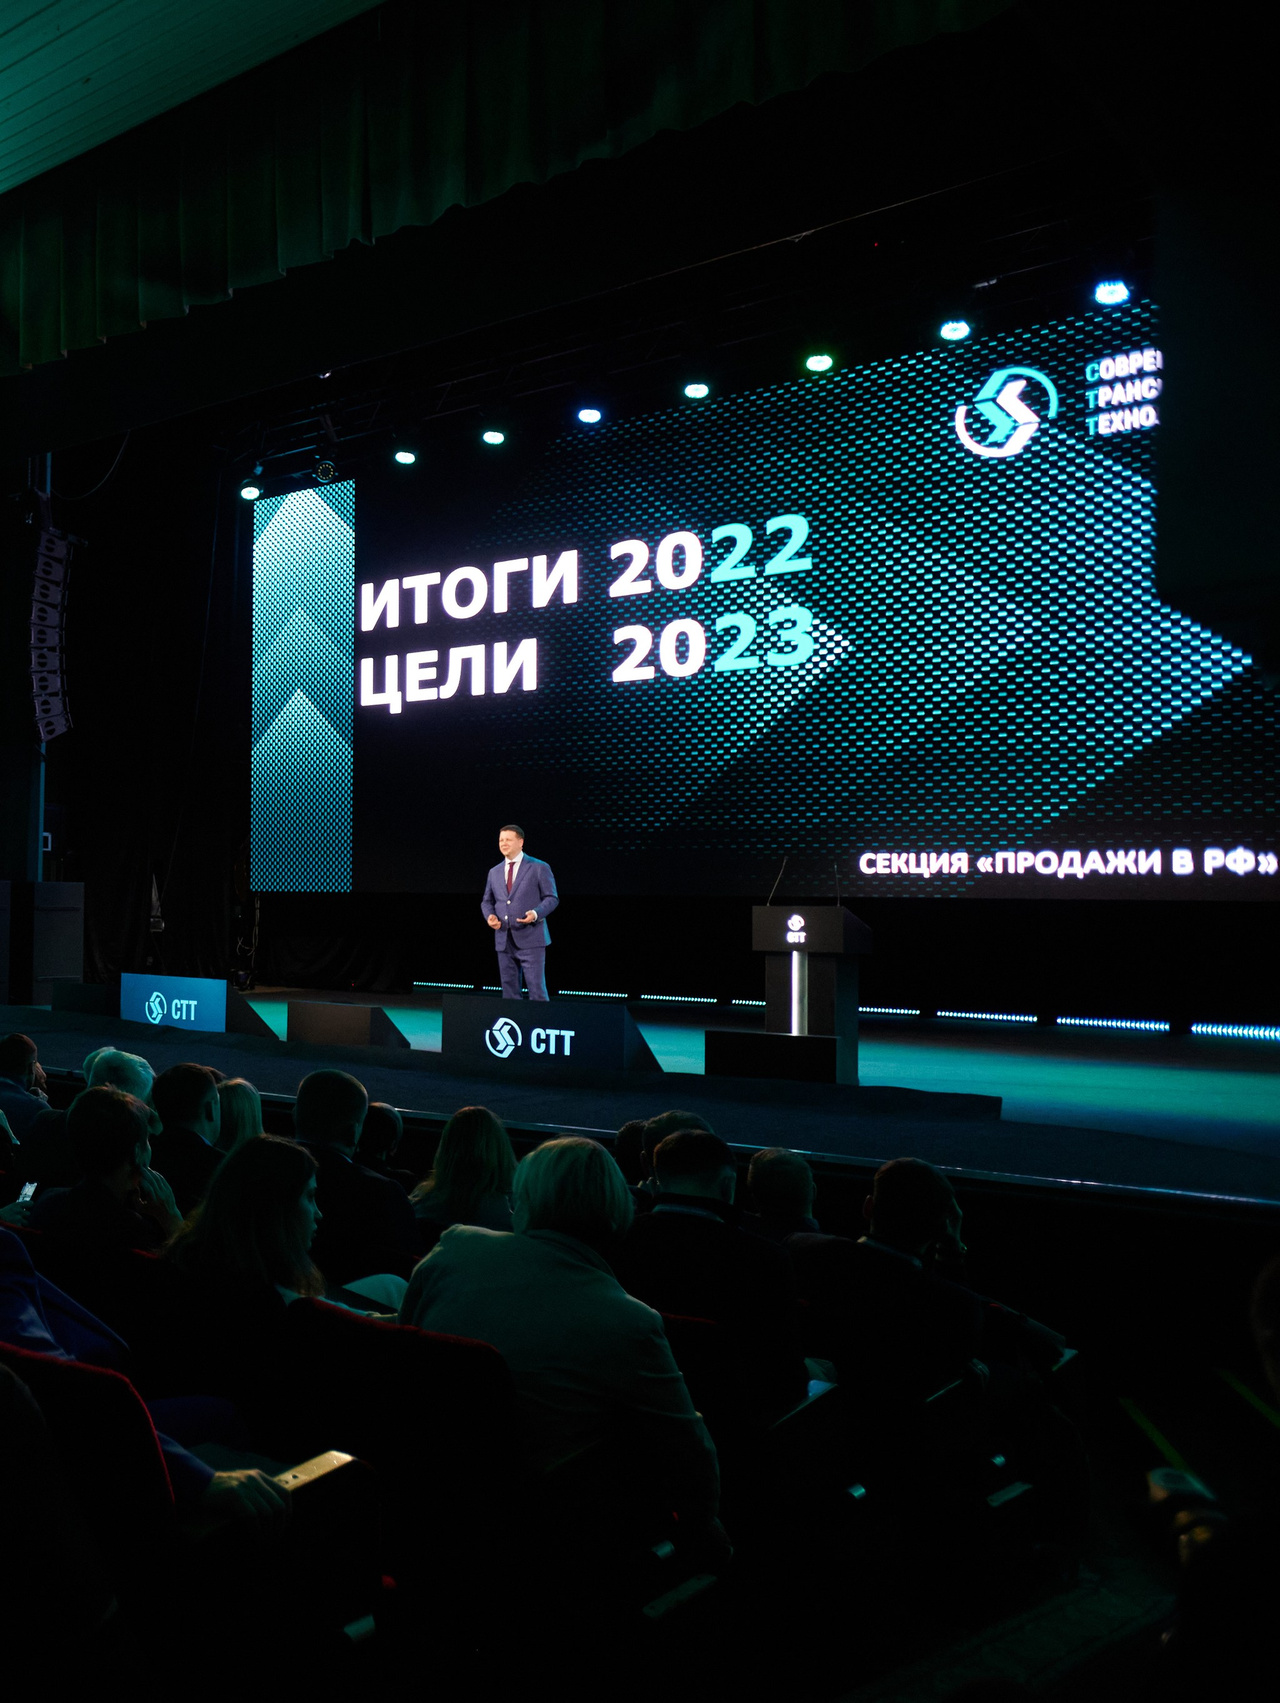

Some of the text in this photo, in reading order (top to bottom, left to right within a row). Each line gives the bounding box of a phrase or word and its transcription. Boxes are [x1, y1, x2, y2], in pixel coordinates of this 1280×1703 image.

[1085, 376, 1163, 409] ТРАНС
[1085, 403, 1160, 436] ТЕХНО
[360, 513, 813, 632] ИТОГИ 2022
[360, 605, 816, 714] ЦЕЛИ 2023
[858, 846, 1279, 880] СЕКЦИЯ «ПРОДАЖИ В РФ»
[171, 998, 198, 1021] СТТ
[530, 1027, 576, 1056] СТТ
